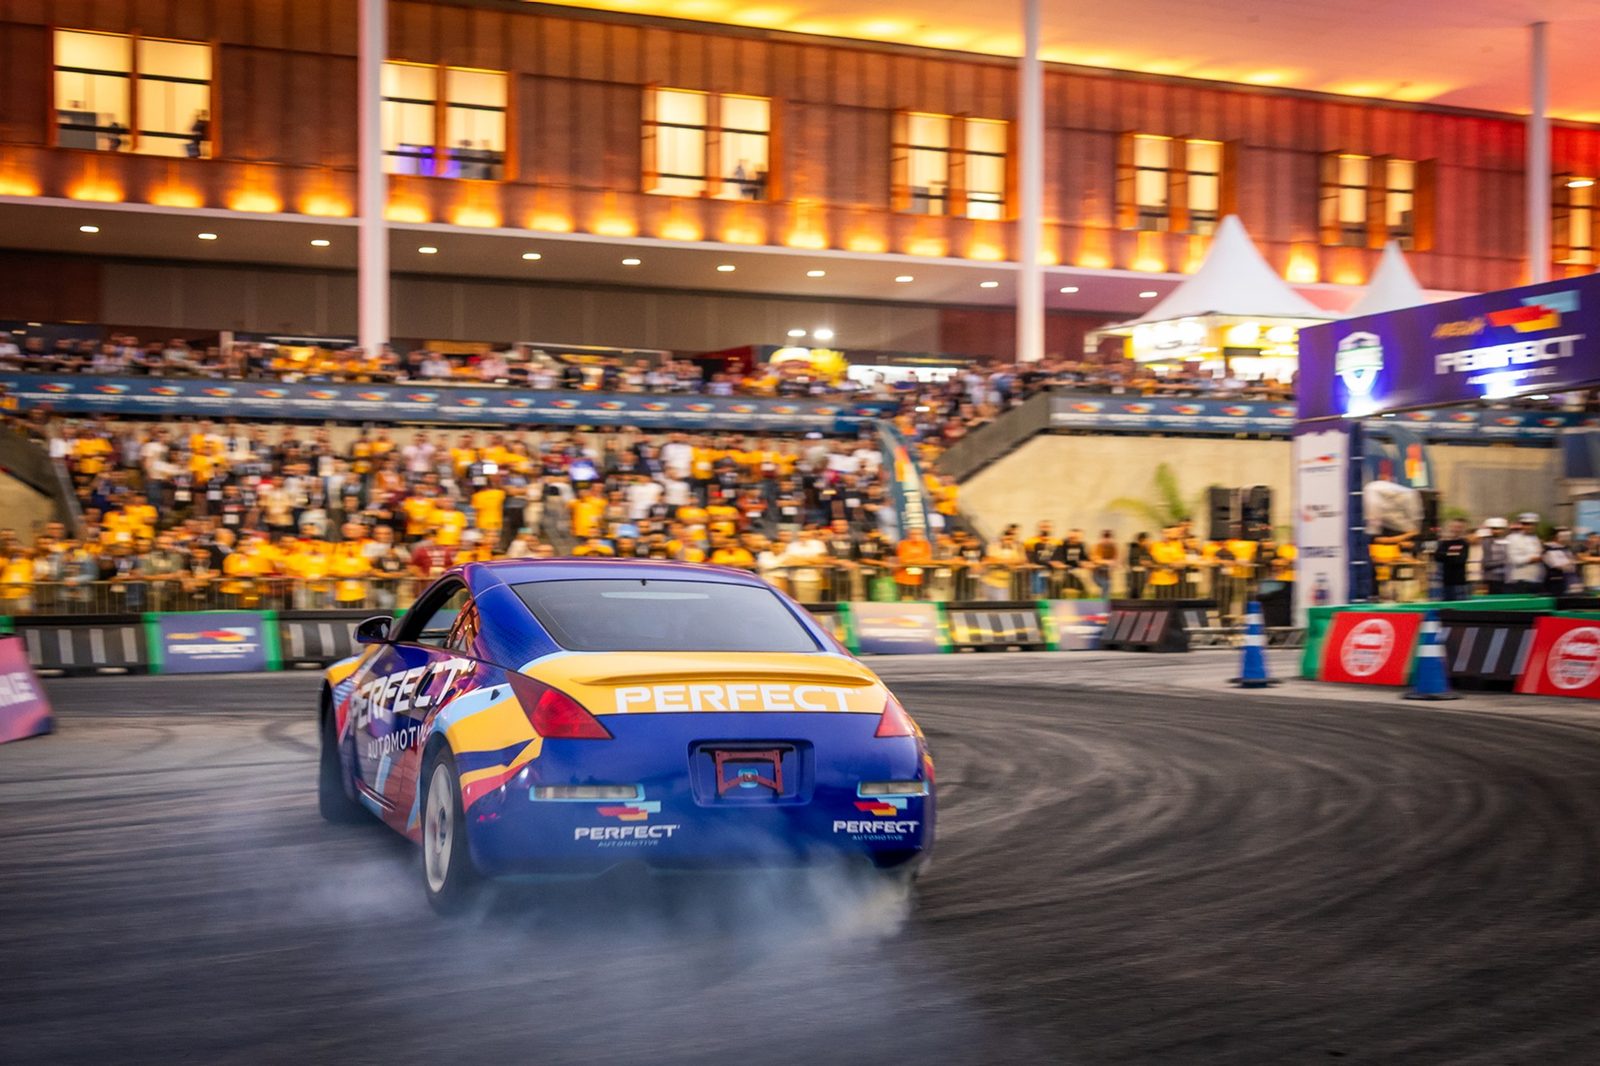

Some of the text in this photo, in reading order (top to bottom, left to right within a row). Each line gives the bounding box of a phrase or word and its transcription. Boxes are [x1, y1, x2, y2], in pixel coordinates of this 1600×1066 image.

[349, 657, 472, 737] PERFECT
[615, 684, 855, 714] PERFECT
[574, 824, 677, 841] PERFECT
[833, 821, 919, 834] PERFECT
[598, 839, 659, 848] AUTOMOTIVE
